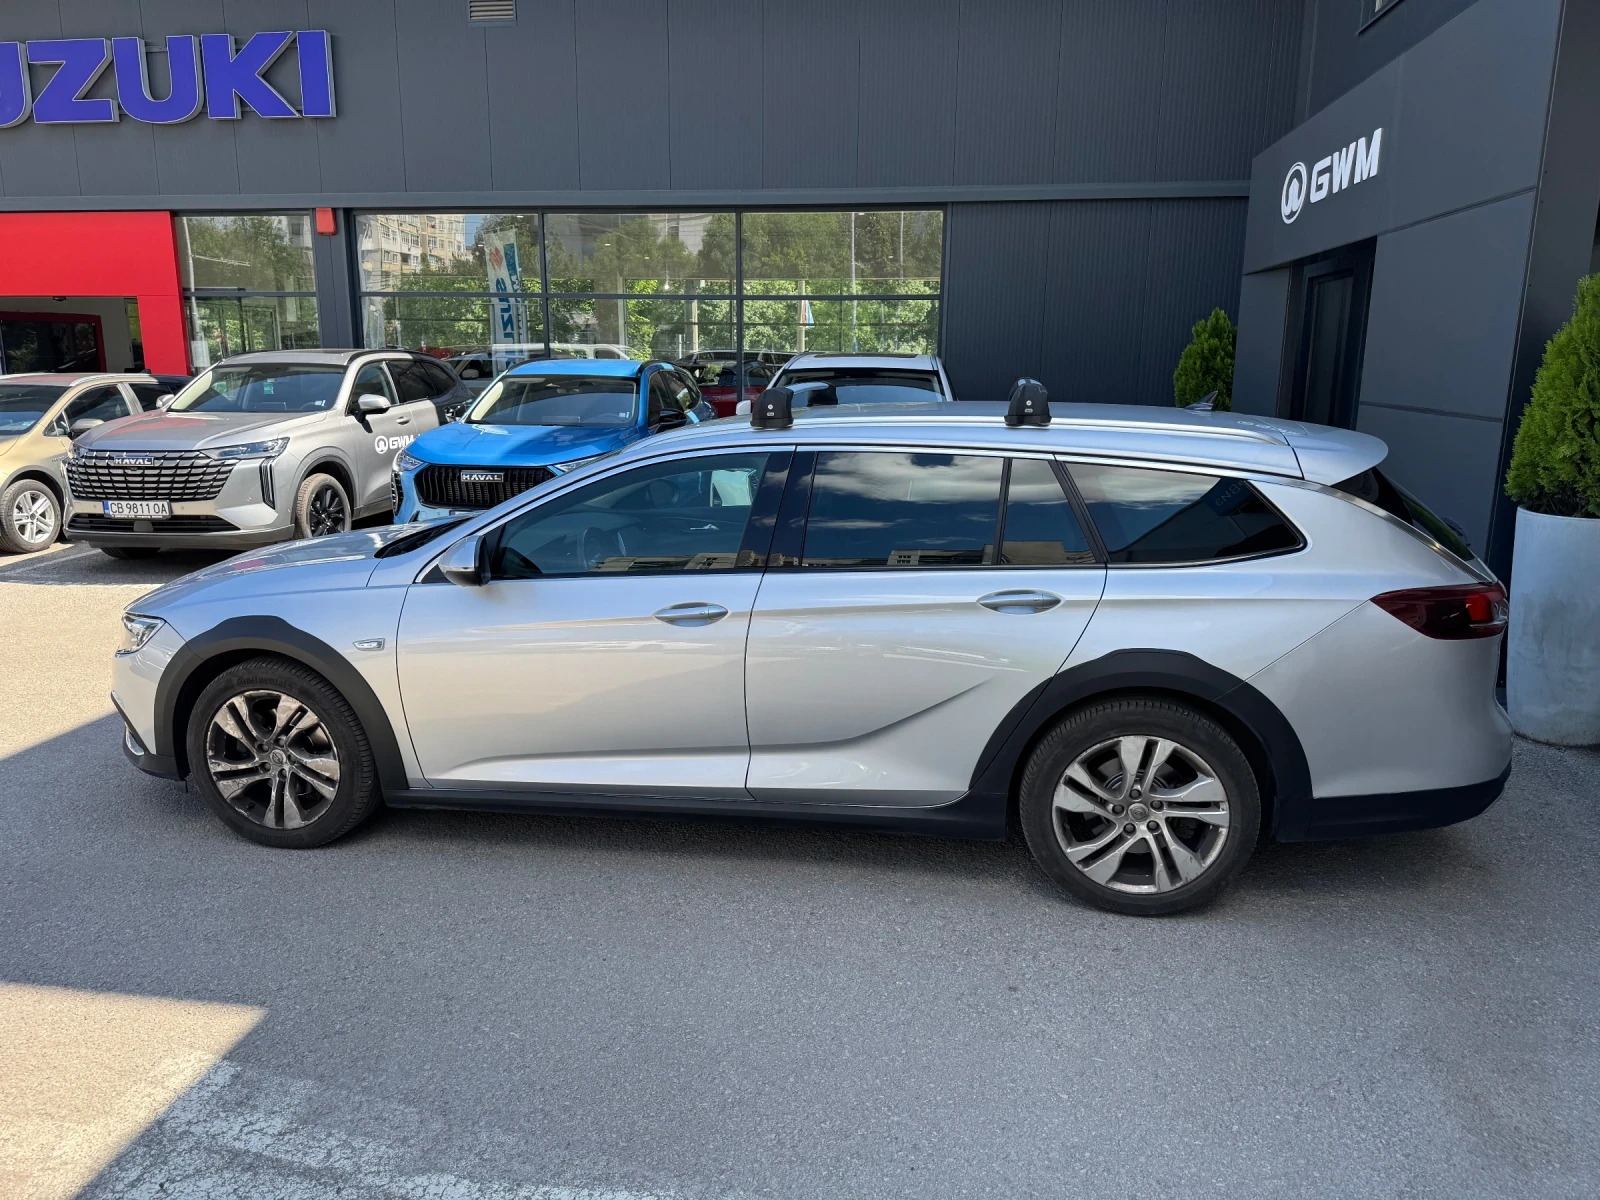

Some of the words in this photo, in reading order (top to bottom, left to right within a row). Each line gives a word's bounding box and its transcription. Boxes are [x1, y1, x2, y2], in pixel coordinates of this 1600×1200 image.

[1310, 127, 1382, 204] GWM
[110, 502, 124, 514] CB
[126, 502, 151, 514] 9811
[236, 675, 288, 689] Continental
